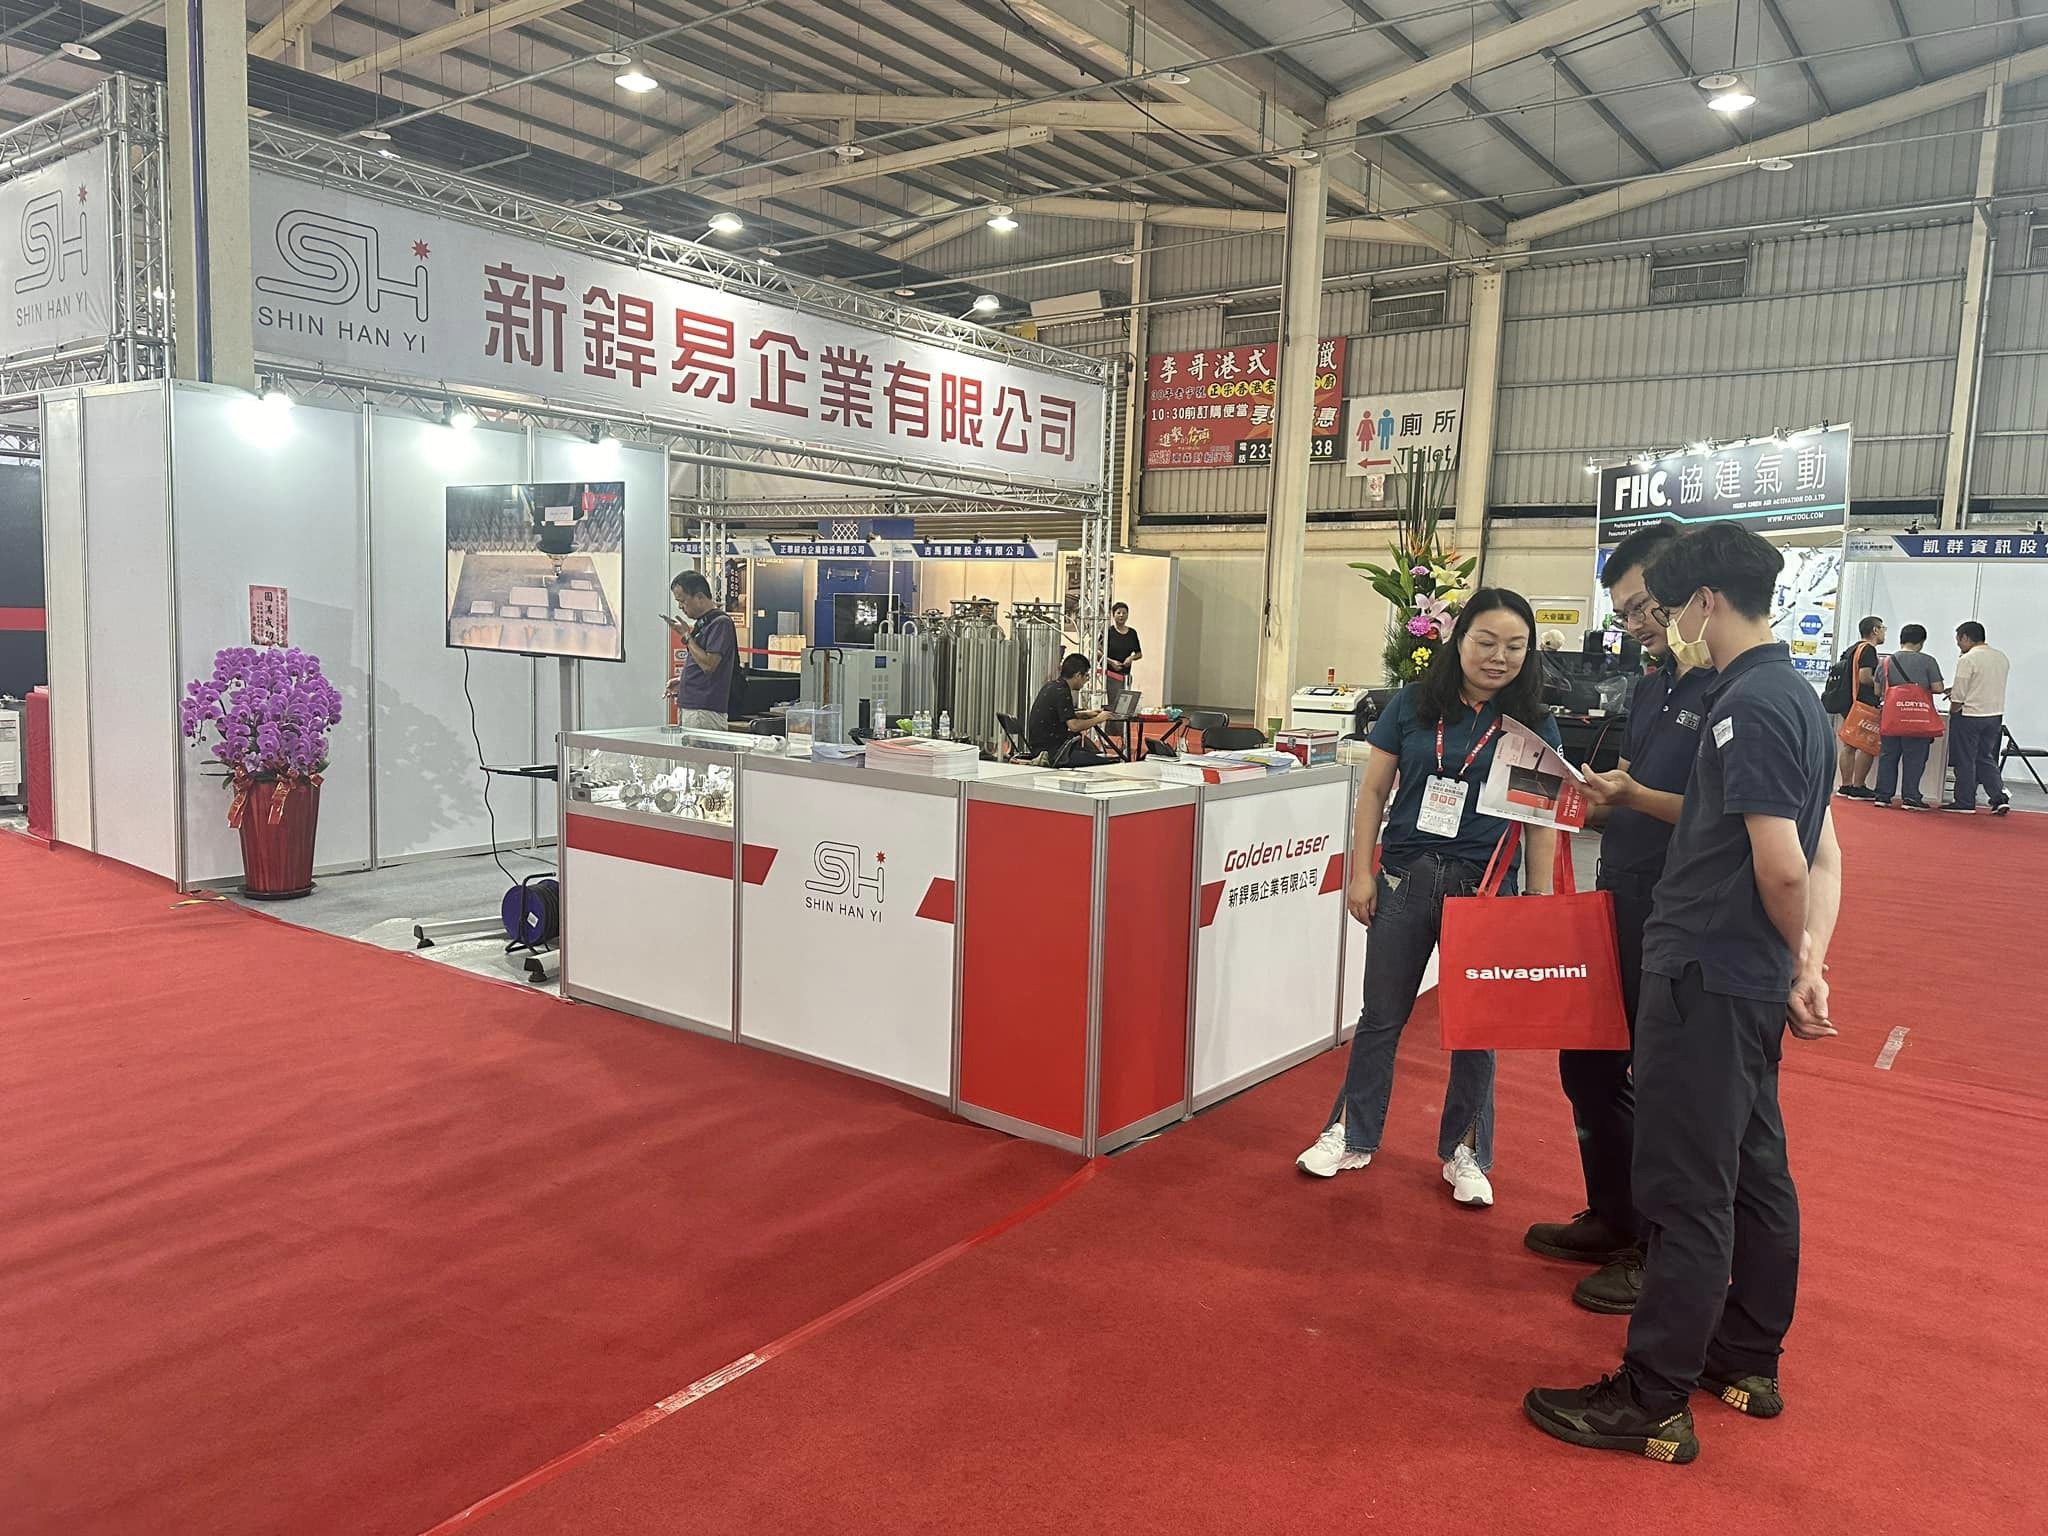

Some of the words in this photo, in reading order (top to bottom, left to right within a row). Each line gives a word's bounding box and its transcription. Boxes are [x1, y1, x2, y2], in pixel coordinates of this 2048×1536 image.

[16, 303, 43, 327] SHIN
[47, 295, 71, 319] HAN
[76, 290, 88, 313] YI
[258, 306, 324, 336] SHIN
[338, 320, 390, 348] HAN
[403, 331, 425, 354] YI
[484, 262, 1076, 462] 新銲易企業有限公司
[1399, 409, 1457, 437] 廁所
[1678, 444, 1828, 505] 協建氣動
[1922, 539, 2048, 555] 凱群資訊股
[1224, 841, 1283, 872] Golden
[1285, 834, 1330, 859] Laser
[1228, 867, 1319, 909] 新銲易企業有限公司
[805, 896, 834, 913] SHIN
[839, 903, 864, 919] HAN
[870, 909, 883, 923] YI
[1465, 964, 1588, 981] salvagnini
